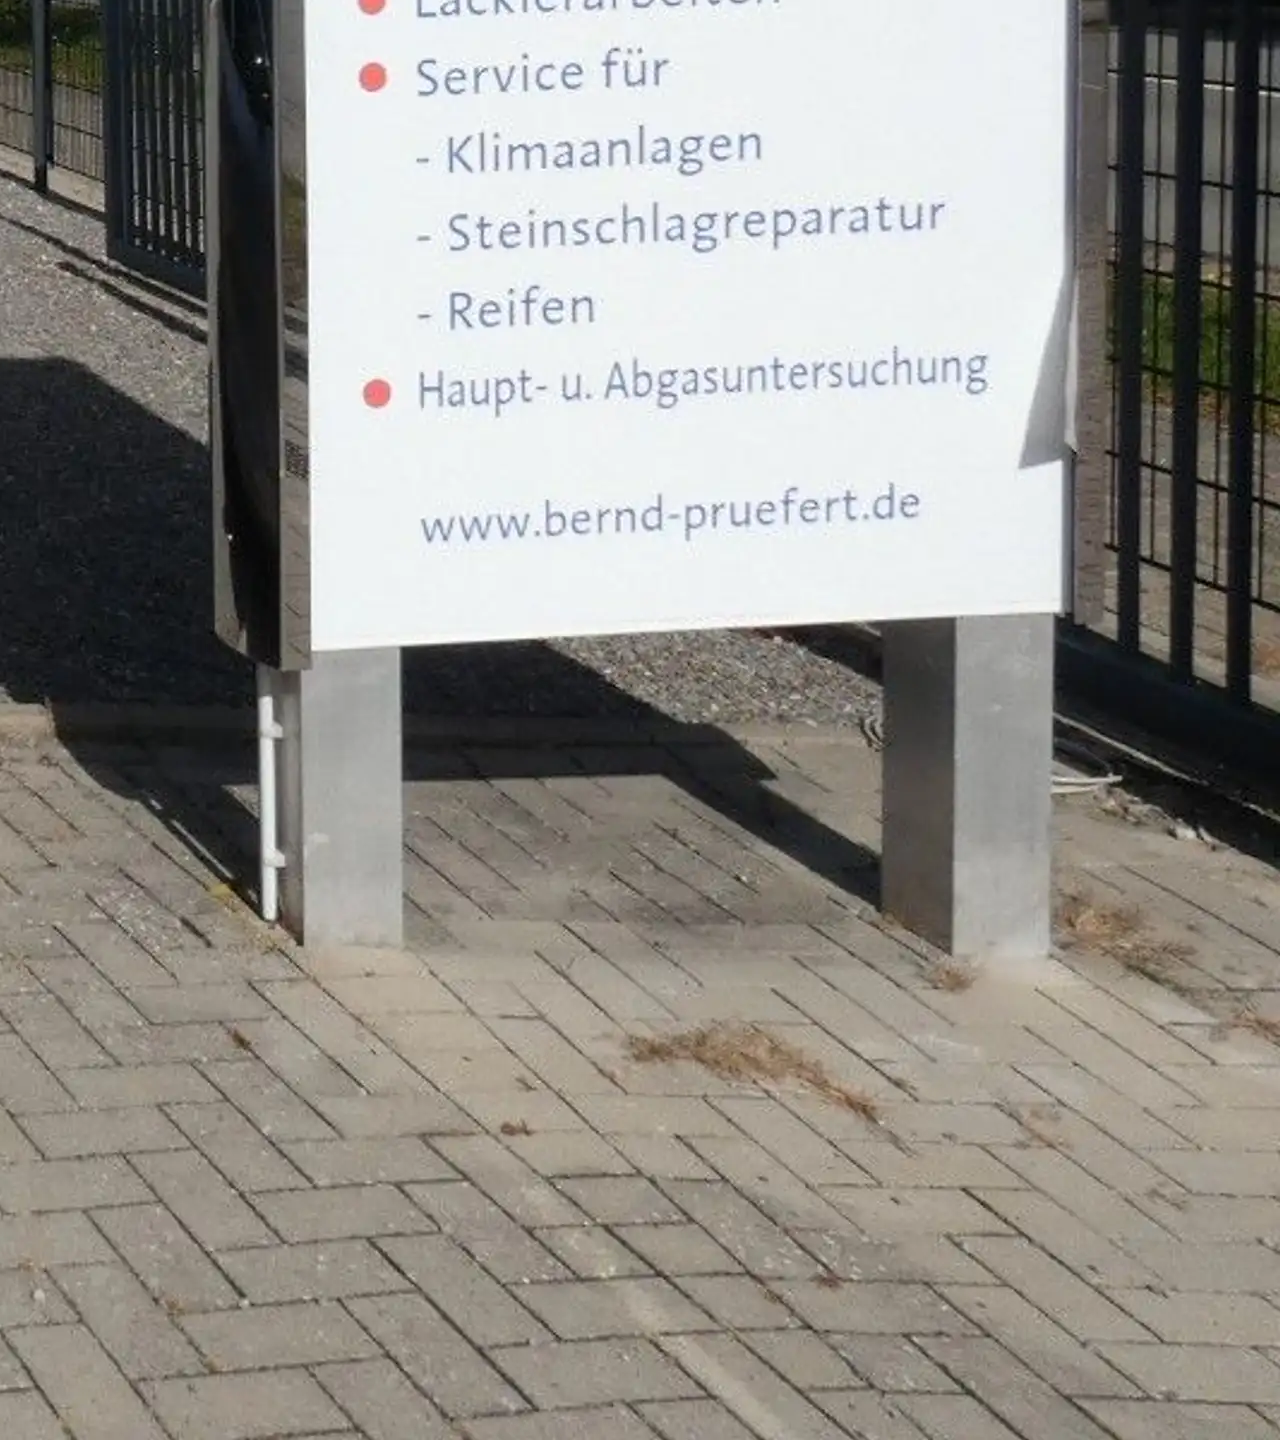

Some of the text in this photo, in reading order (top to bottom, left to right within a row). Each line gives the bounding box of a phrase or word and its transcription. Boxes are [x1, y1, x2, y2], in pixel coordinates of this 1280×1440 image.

[416, 46, 671, 98] Service für
[447, 124, 762, 177] Klimaanlagen
[448, 196, 946, 254] Steinschlagreparatur
[449, 284, 595, 331] Reifen
[418, 345, 989, 419] Haupt- u. Abgasuntersuchung
[420, 481, 921, 544] www.bernd-pruefert.de
